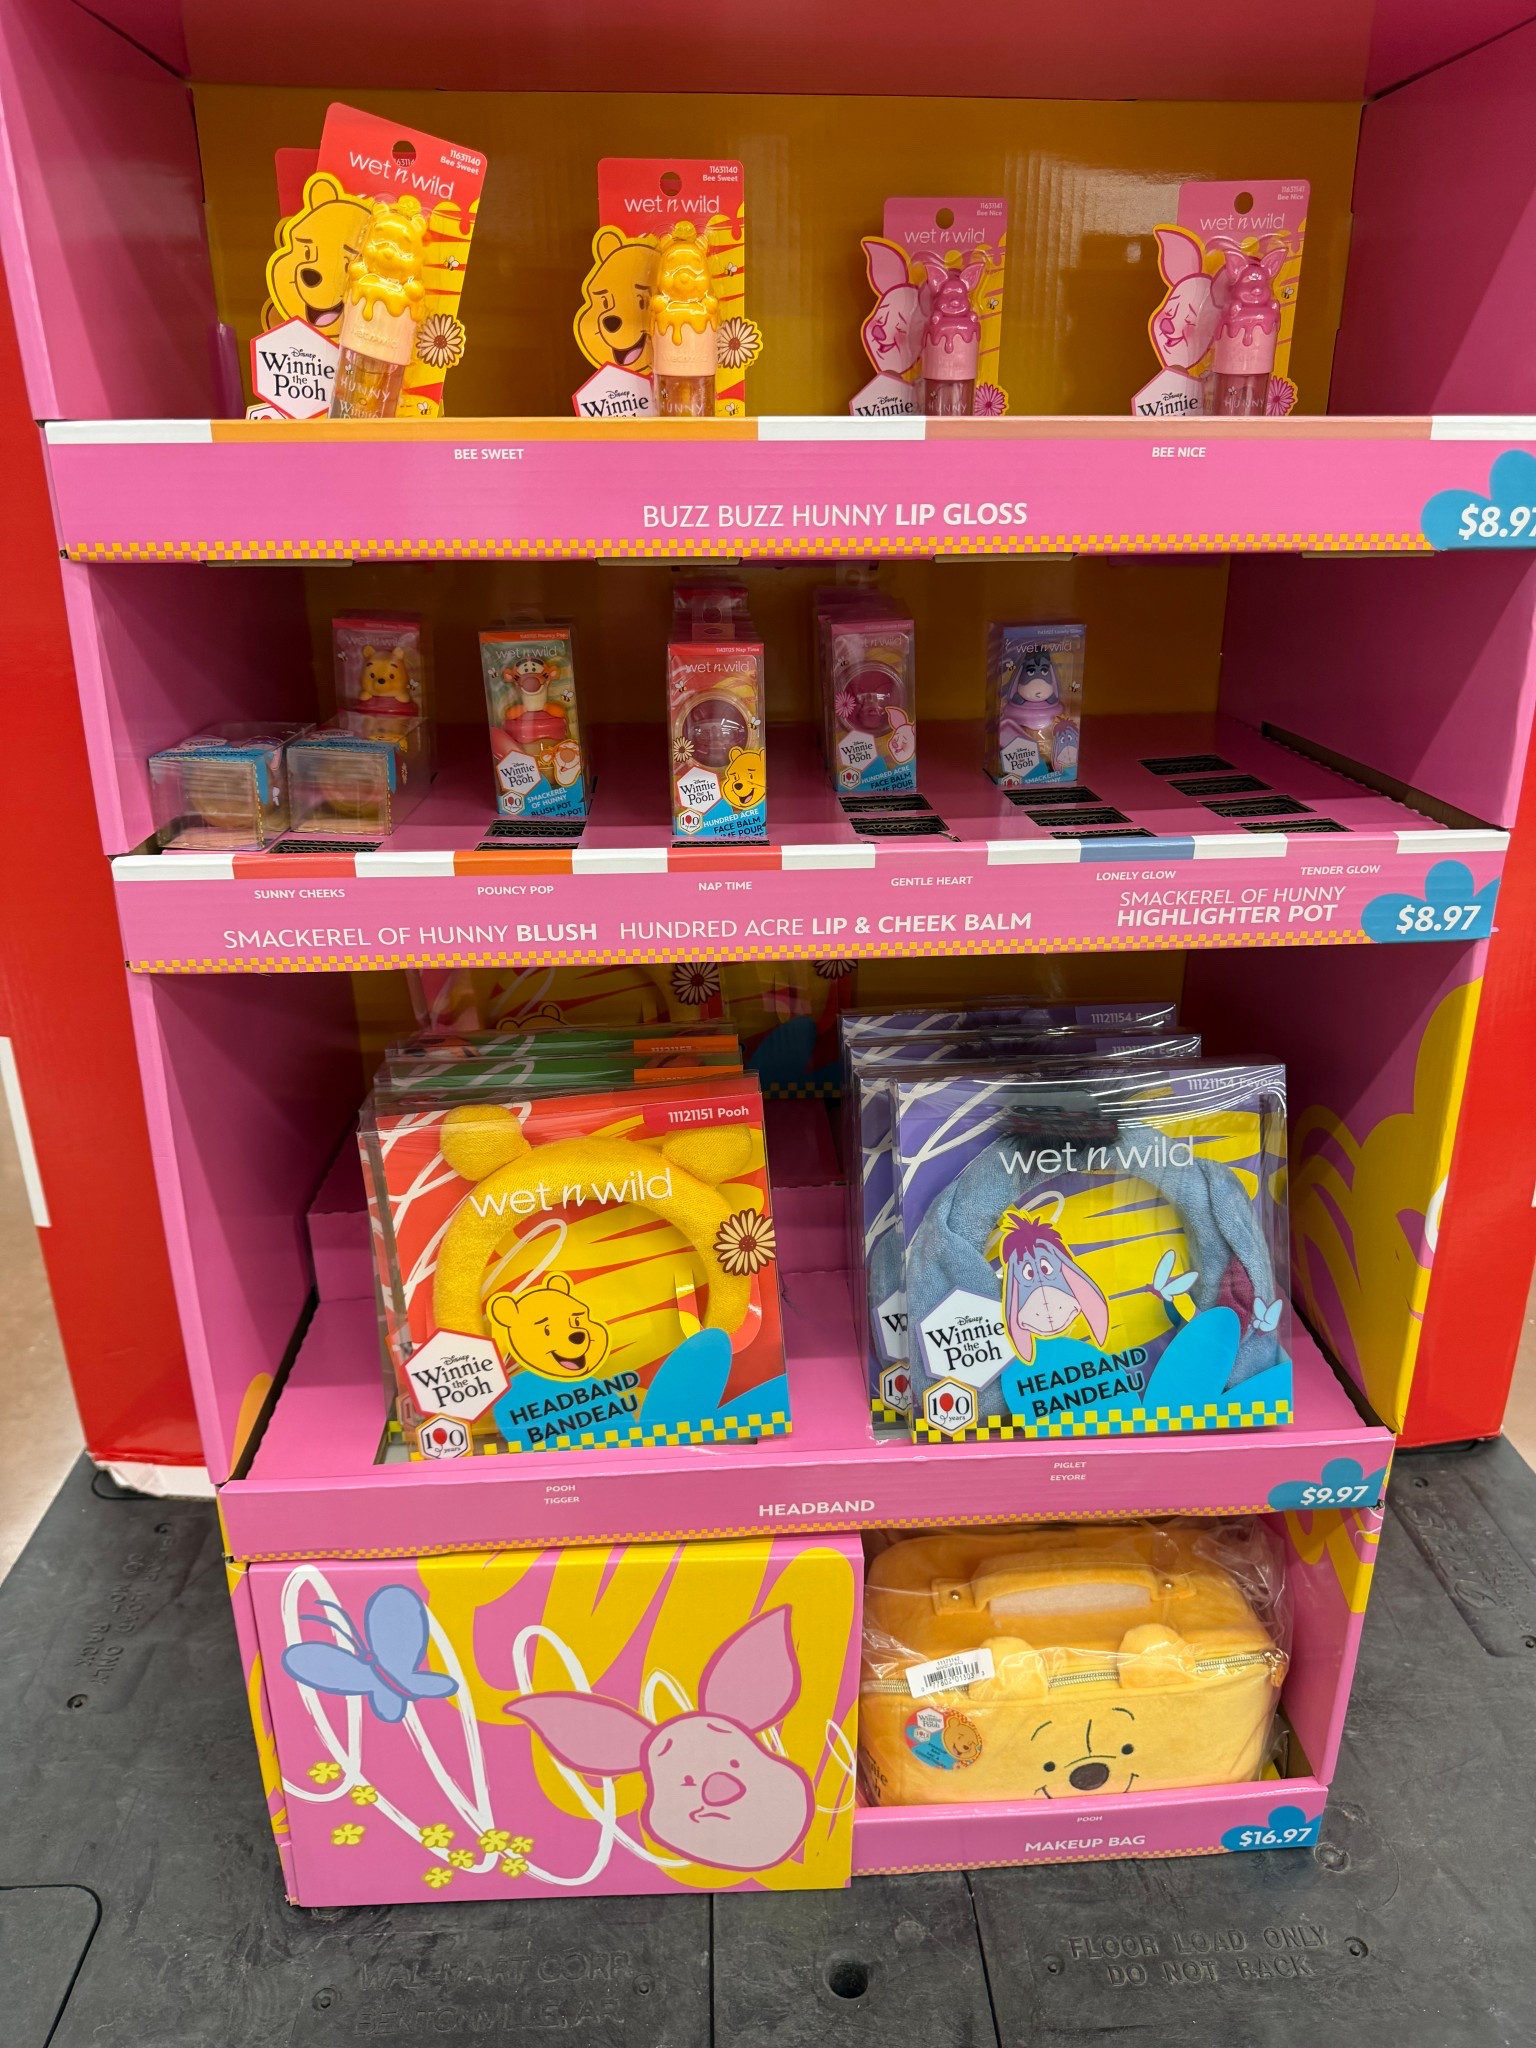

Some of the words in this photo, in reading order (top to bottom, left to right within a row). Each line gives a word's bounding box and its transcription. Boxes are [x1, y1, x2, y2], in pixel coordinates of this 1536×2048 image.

[440, 155, 456, 166] Bee
[456, 161, 480, 175] Sweet
[450, 150, 481, 166] 11631140
[349, 151, 390, 179] wet
[394, 166, 408, 185] n
[411, 171, 454, 200] wild
[702, 174, 716, 182] Bee
[717, 174, 738, 182] Sweet
[709, 166, 738, 174] 11631140
[624, 196, 663, 213] wet
[666, 197, 679, 212] n
[682, 196, 720, 214] wild
[1200, 215, 1235, 231] wet
[1237, 216, 1249, 230] n
[1251, 213, 1285, 231] wild
[904, 229, 938, 244] wet
[940, 230, 951, 244] n
[952, 228, 985, 244] wild
[258, 351, 335, 380] Winnie
[273, 373, 326, 402] Pooh
[292, 375, 308, 386] the
[580, 394, 649, 417] Winnie
[855, 399, 914, 417] Winnie
[1138, 397, 1199, 417] Winnie
[454, 448, 478, 460] BEE
[481, 448, 524, 460] SWEET
[1151, 447, 1175, 458] BEE
[1176, 447, 1206, 458] NICE
[643, 505, 709, 528] BUZZ
[718, 505, 784, 527] BUZZ
[792, 504, 888, 527] HUNNY
[895, 502, 935, 526] LIP
[942, 502, 1028, 526] GLOSS
[495, 648, 521, 659] wet
[530, 646, 557, 658] wild
[1015, 643, 1038, 653] wet
[1050, 641, 1072, 652] wild
[685, 662, 712, 673] wet
[713, 662, 722, 673] n
[723, 660, 750, 673] wild
[840, 742, 873, 756] Winnie
[1003, 749, 1036, 763] Winnie
[848, 751, 872, 765] Pooh
[1010, 758, 1034, 771] Pooh
[500, 764, 535, 778] Winnie
[861, 771, 892, 784] HUNDRED
[893, 765, 910, 775] ACRE
[1024, 770, 1062, 784] SMACKEREL
[509, 773, 535, 788] Pooh
[870, 778, 889, 789] FACE
[890, 772, 912, 784] BALM
[891, 779, 913, 791] POUR
[527, 787, 568, 804] SMACKEREL
[679, 780, 716, 798] Winnie
[531, 801, 541, 809] OF
[542, 794, 567, 807] HUNNY
[556, 801, 572, 811] POT
[688, 792, 715, 806] Pooh
[567, 807, 583, 817] POT
[703, 813, 739, 828] HUNDRED
[740, 808, 759, 819] ACRE
[713, 822, 735, 834] FACE
[736, 816, 761, 829] BALM
[738, 824, 764, 836] POUR
[1096, 871, 1140, 882] LONELY
[1141, 870, 1176, 880] GLOW
[1300, 865, 1344, 876] TENDER
[1346, 864, 1381, 875] GLOW
[698, 882, 722, 892] NAP
[724, 881, 753, 891] TIME
[890, 876, 934, 887] GENTLE
[936, 875, 973, 886] HEART
[253, 889, 296, 900] SUNNY
[298, 888, 346, 899] CHEEKS
[477, 886, 526, 896] POUNCY
[530, 885, 555, 895] POP
[1119, 889, 1235, 907] SMACKEREL
[1240, 888, 1267, 904] OF
[1273, 886, 1346, 903] HUNNY
[1116, 906, 1280, 927] HIGHLIGHTER
[1287, 904, 1338, 923] POT
[1395, 904, 1482, 934] $8.97
[620, 919, 737, 940] HUNDRED
[744, 918, 804, 937] ACRE
[811, 917, 848, 936] LIP
[854, 916, 871, 934] &
[877, 914, 957, 934] CHEEK
[963, 912, 1032, 931] BALM
[223, 927, 371, 950] SMACKEREL
[377, 927, 411, 946] OF
[419, 925, 509, 945] HUNNY
[516, 923, 598, 942] BLUSH
[1091, 1012, 1133, 1025] 11121154
[1187, 1078, 1236, 1091] 11121154
[668, 1108, 714, 1124] 11121151
[717, 1106, 750, 1119] Pooh
[998, 1146, 1077, 1176] wet
[1086, 1147, 1111, 1172] n
[1116, 1136, 1195, 1170] wild
[469, 1182, 553, 1218] wet
[562, 1184, 587, 1210] n
[591, 1167, 673, 1205] wild
[956, 1316, 984, 1327] Disney
[926, 1321, 1005, 1349] Winnie
[963, 1342, 980, 1352] the
[443, 1354, 470, 1366] Disney
[943, 1346, 1002, 1371] Pooh
[411, 1355, 495, 1388] Winnie
[1016, 1347, 1148, 1398] HEADBAND
[452, 1378, 470, 1389] the
[432, 1382, 494, 1409] Pooh
[509, 1372, 640, 1426] HEADBAND
[1032, 1372, 1144, 1418] BANDEAU
[527, 1394, 639, 1445] BANDEAU
[947, 1413, 966, 1422] years
[443, 1445, 461, 1455] years
[1053, 1461, 1087, 1470] PIGLET
[1050, 1473, 1087, 1482] EEYORE
[545, 1484, 576, 1493] POOH
[1299, 1485, 1369, 1506] $9.97
[543, 1496, 580, 1505] TIGGER
[758, 1500, 875, 1517] HEADBAND
[1024, 1838, 1104, 1853] MAKEUP
[1108, 1835, 1146, 1847] BAG
[1239, 1827, 1312, 1847] $16.97
[1069, 1934, 1159, 1959] FLOOR
[1173, 1929, 1248, 1954] LOAD
[1263, 1925, 1329, 1950] ONLY
[1107, 1962, 1147, 1986] DO
[1162, 1959, 1218, 1983] NOT
